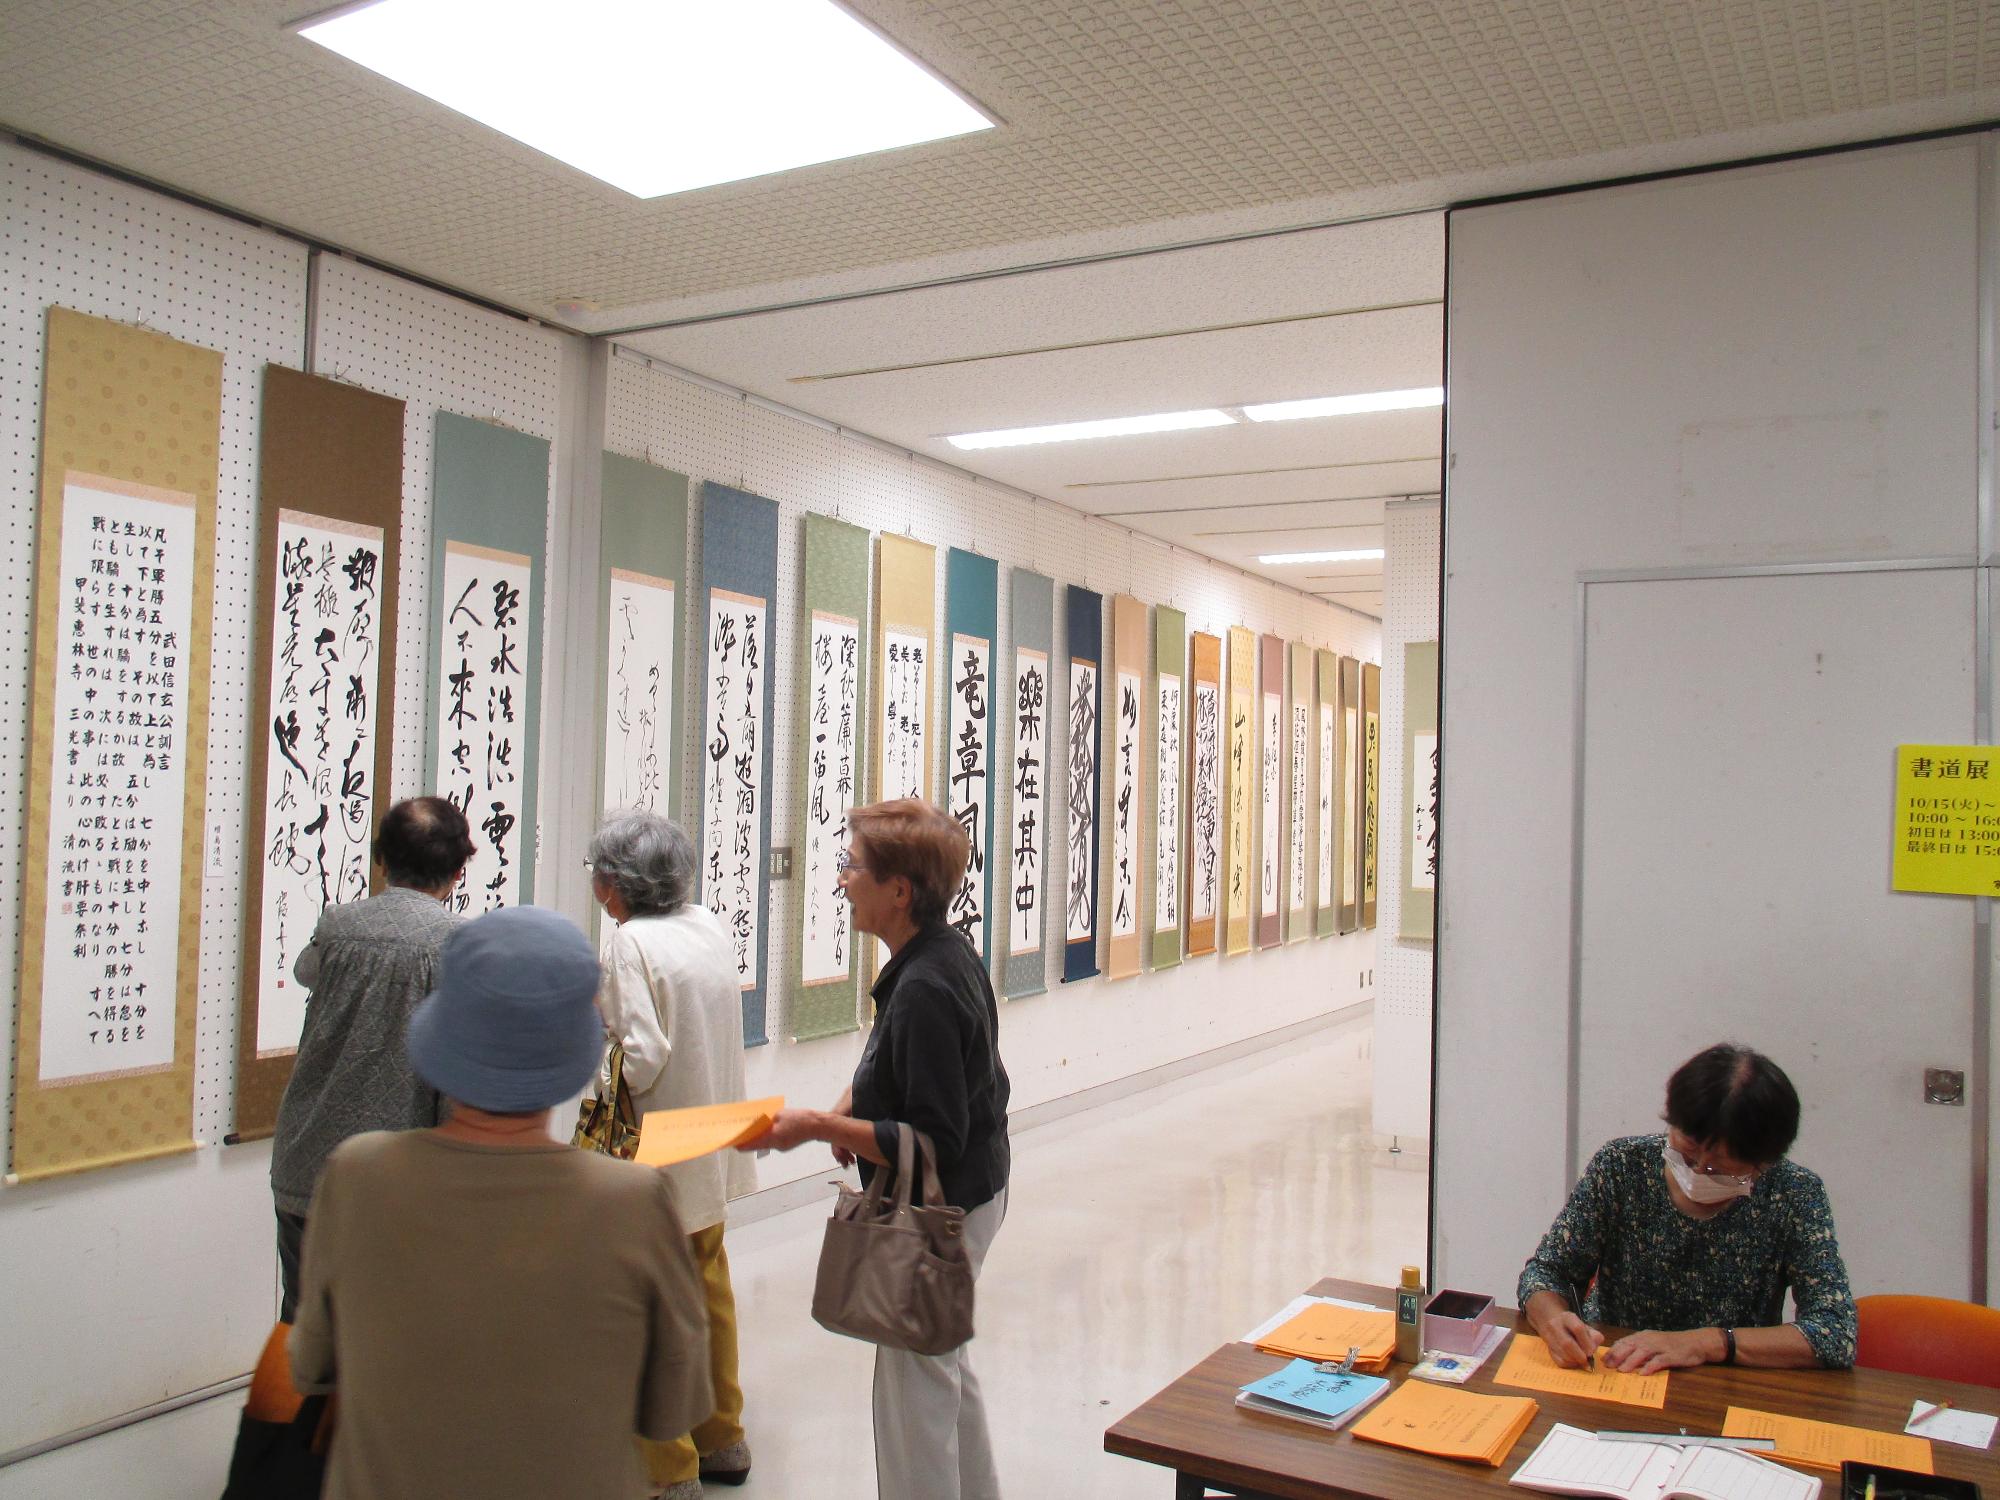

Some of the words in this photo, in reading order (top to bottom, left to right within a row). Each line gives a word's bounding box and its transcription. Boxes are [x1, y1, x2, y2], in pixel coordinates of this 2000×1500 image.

[158, 631, 177, 770] 武田信玄公訓言
[1910, 757, 1989, 780] 書道展
[1909, 812, 1949, 824] 10:00
[1907, 827, 1951, 839] 初日は
[1906, 840, 1968, 854] 最終日は
